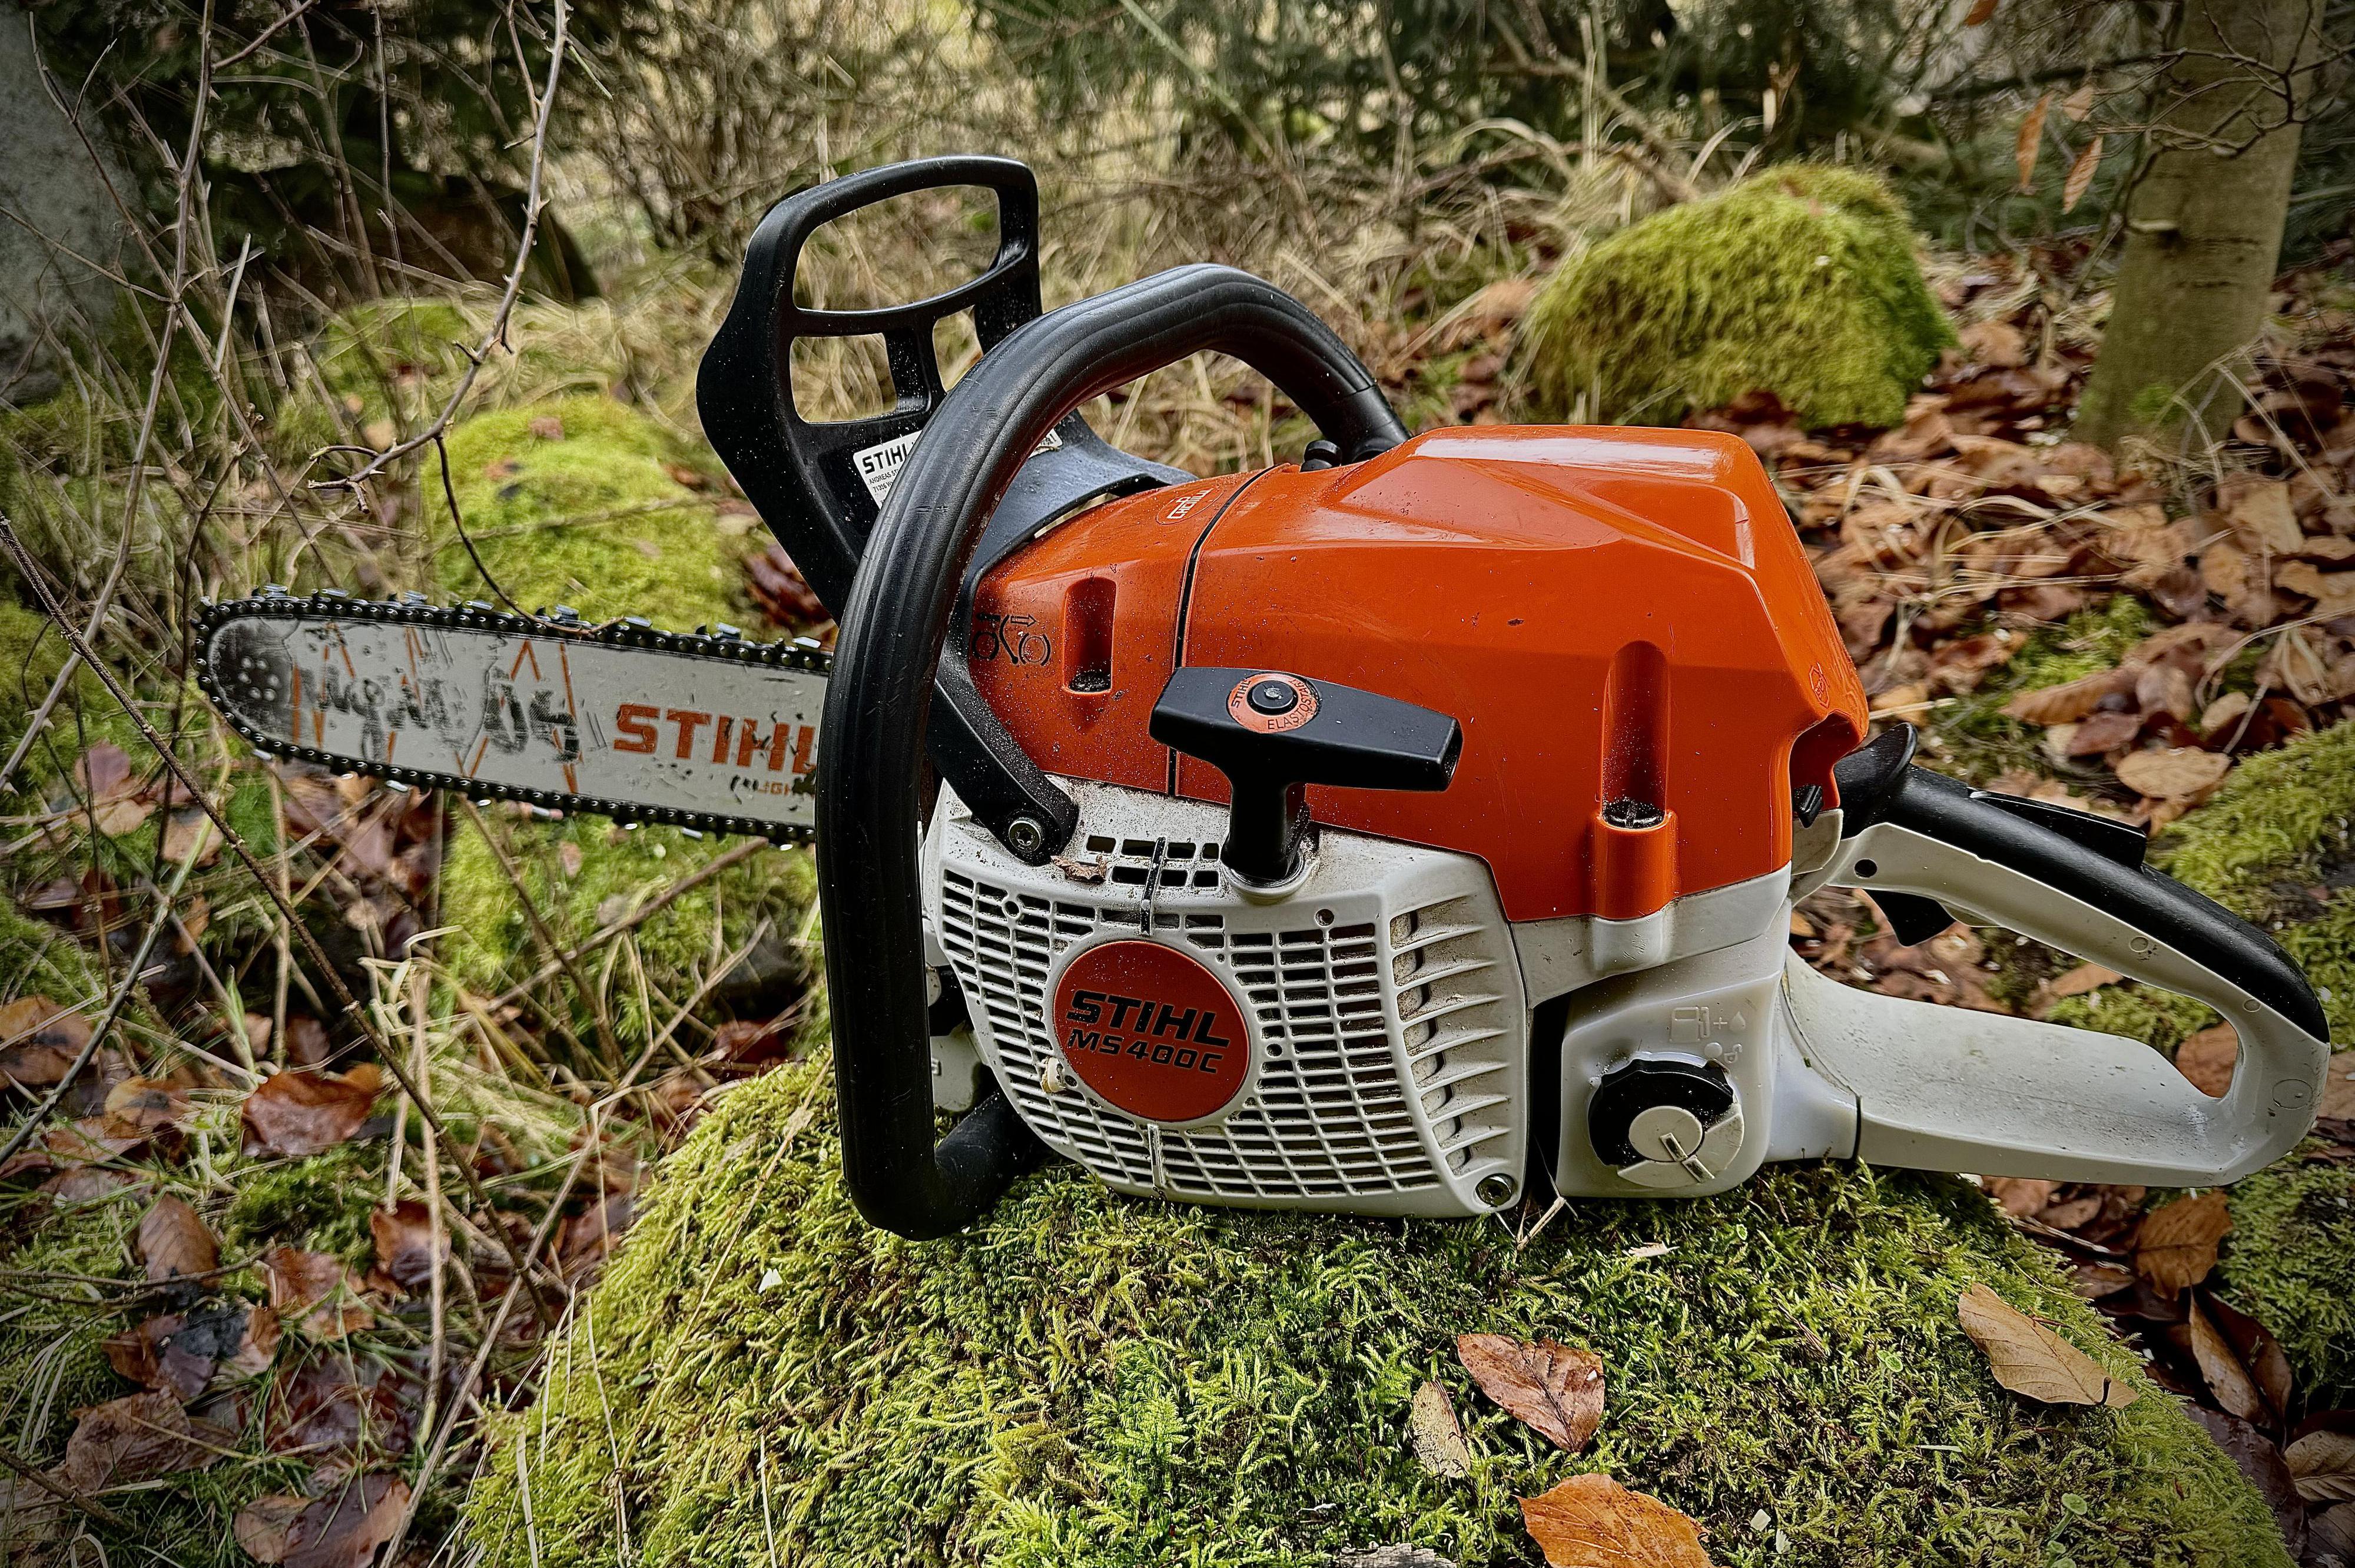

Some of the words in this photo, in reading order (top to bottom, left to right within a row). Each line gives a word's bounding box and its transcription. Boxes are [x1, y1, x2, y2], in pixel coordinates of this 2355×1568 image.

[1232, 680, 1252, 708] STIHL
[1267, 679, 1312, 730] ELASTOSTART
[613, 704, 817, 775] STIHL
[1066, 989, 1230, 1048] STIHL
[1067, 1028, 1124, 1055] MS
